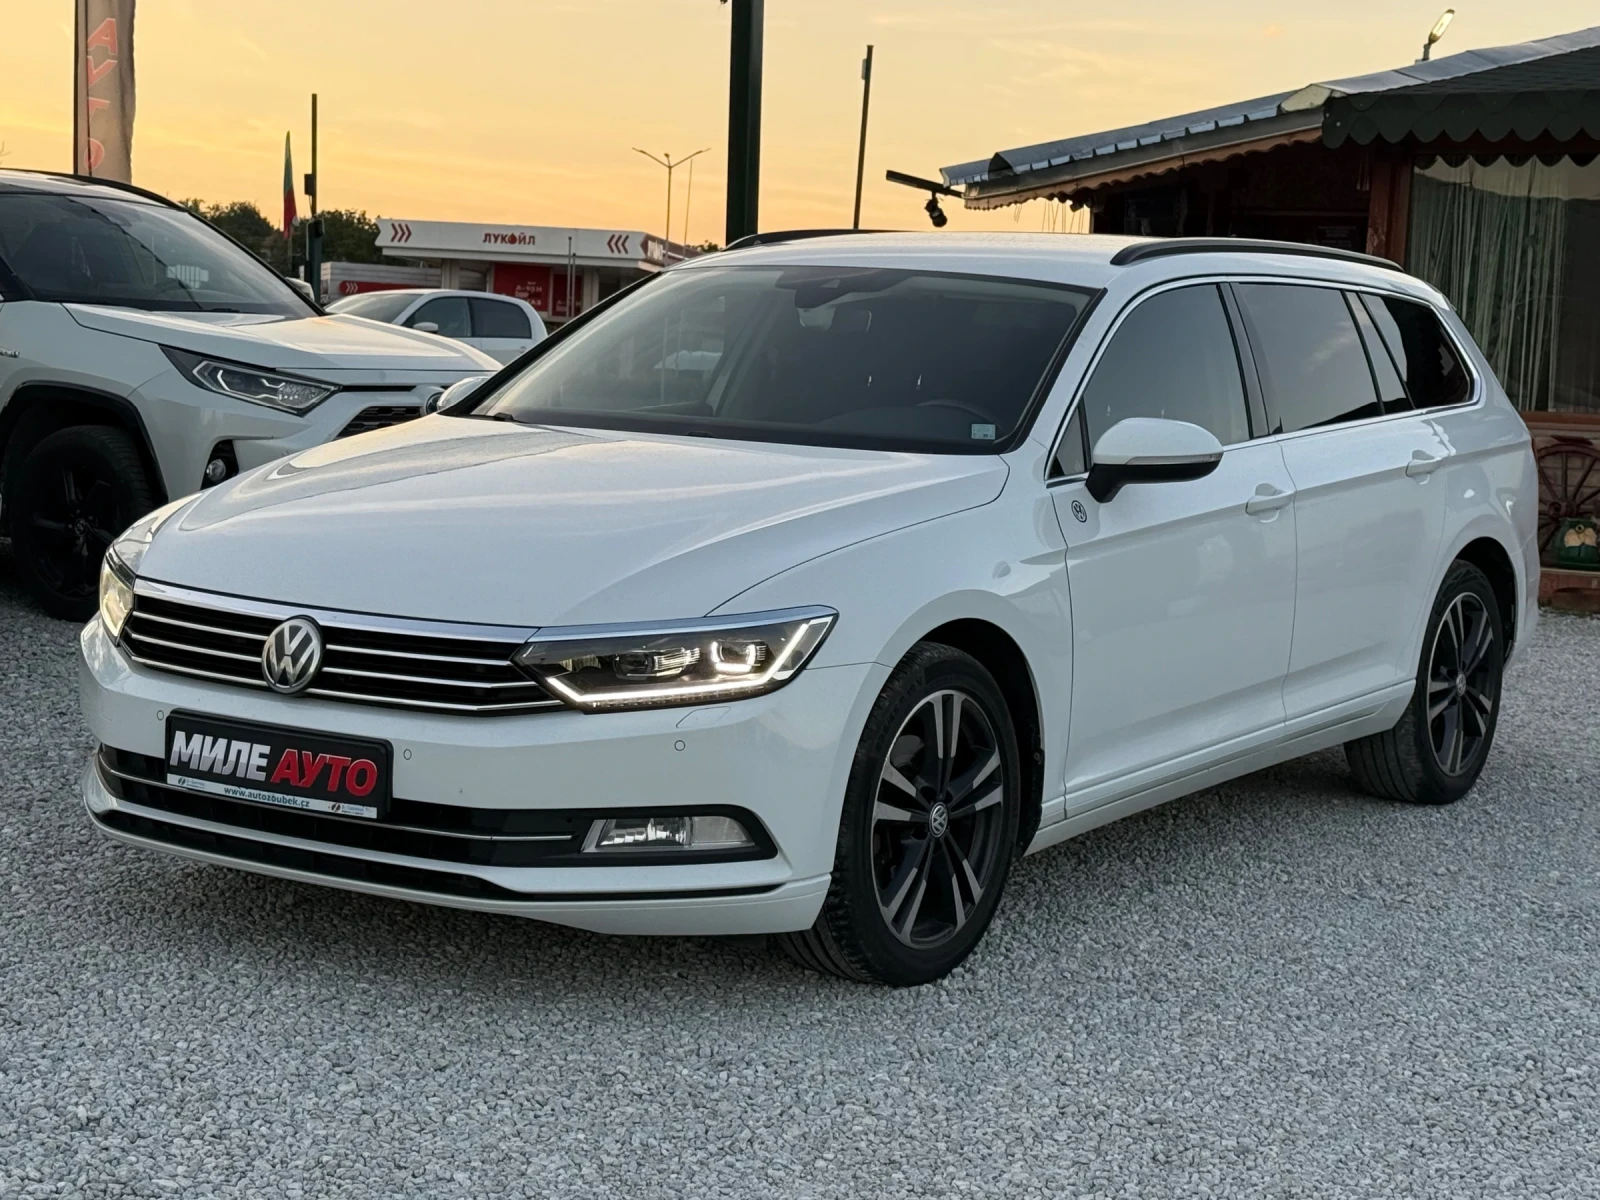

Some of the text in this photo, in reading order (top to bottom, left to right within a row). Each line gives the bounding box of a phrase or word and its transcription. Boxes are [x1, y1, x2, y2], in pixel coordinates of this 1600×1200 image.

[482, 231, 536, 246] ЛУКОЙЛ
[169, 730, 378, 797] МИЛЕ АУТО
[223, 786, 311, 809] www.autozoubek.cz
